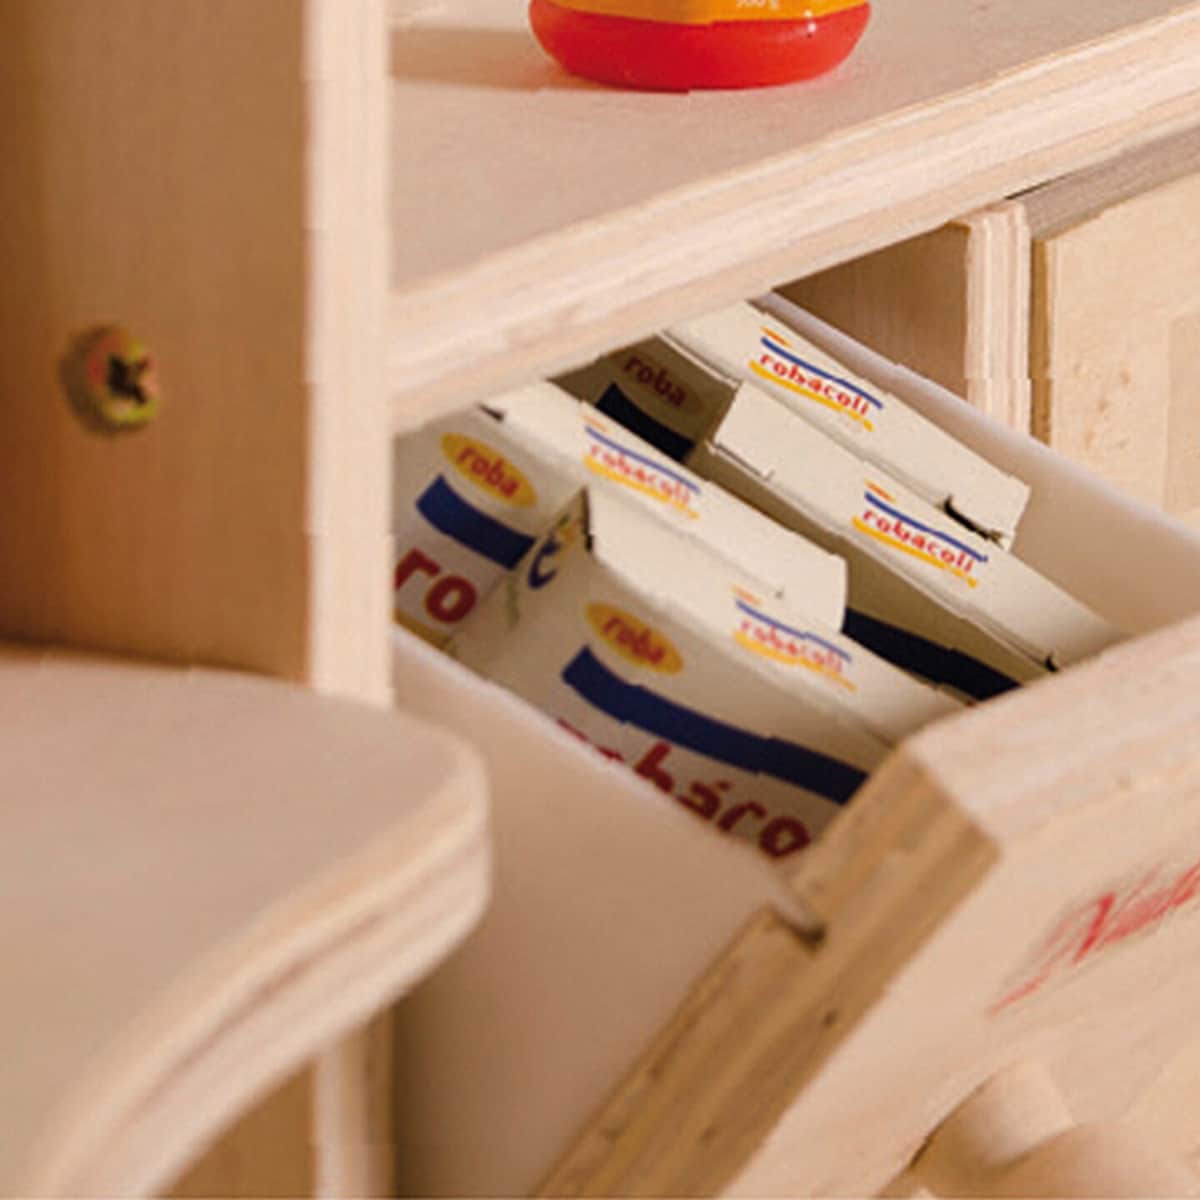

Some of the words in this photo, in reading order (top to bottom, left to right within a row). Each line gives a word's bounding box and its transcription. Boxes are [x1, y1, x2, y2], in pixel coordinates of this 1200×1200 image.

[624, 356, 687, 409] roba
[760, 353, 870, 416] robacoli
[455, 447, 519, 499] roba
[863, 508, 974, 573] robacoli
[601, 615, 668, 666] roba
